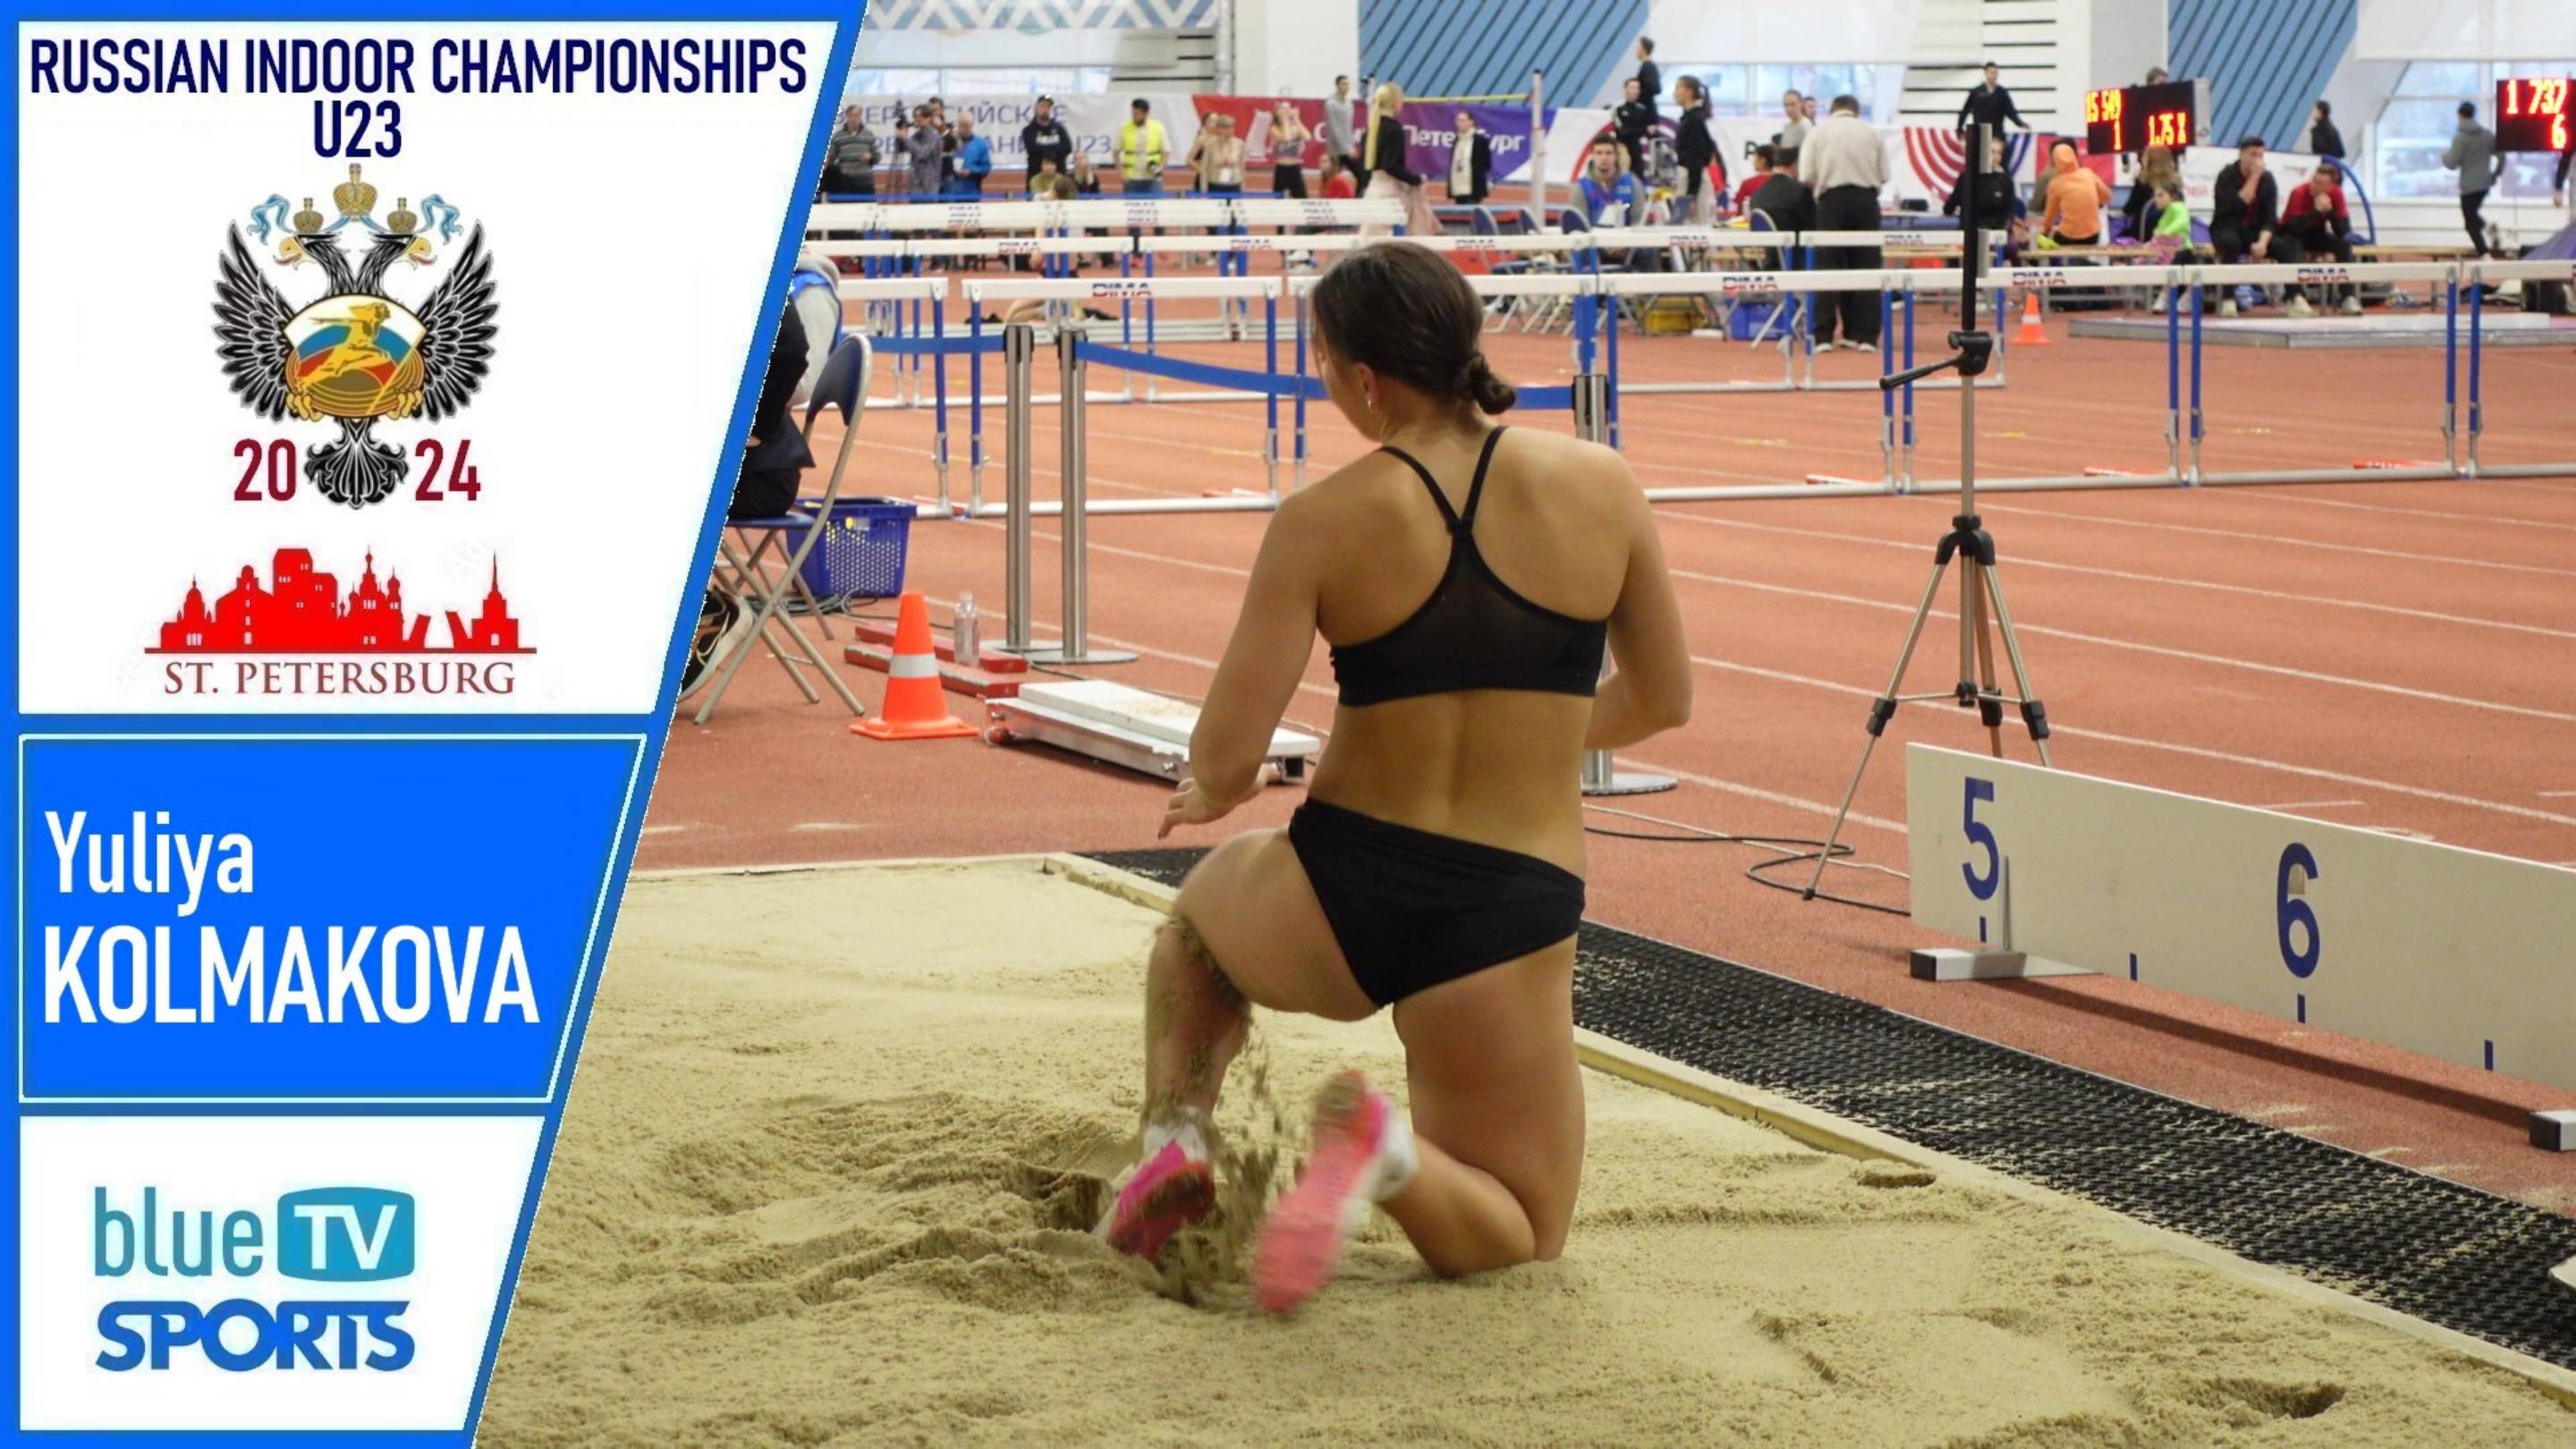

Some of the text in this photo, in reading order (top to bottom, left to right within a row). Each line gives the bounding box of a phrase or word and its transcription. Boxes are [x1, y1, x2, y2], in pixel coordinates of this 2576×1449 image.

[2114, 119, 2122, 150] 1
[2552, 113, 2567, 149] 6
[1723, 275, 1778, 291] DIMA
[2012, 271, 2067, 285] DIMA
[2297, 267, 2350, 283] DIMA
[1092, 282, 1153, 297] DIMA
[1962, 776, 2000, 900] 5
[2277, 843, 2320, 979] 6
